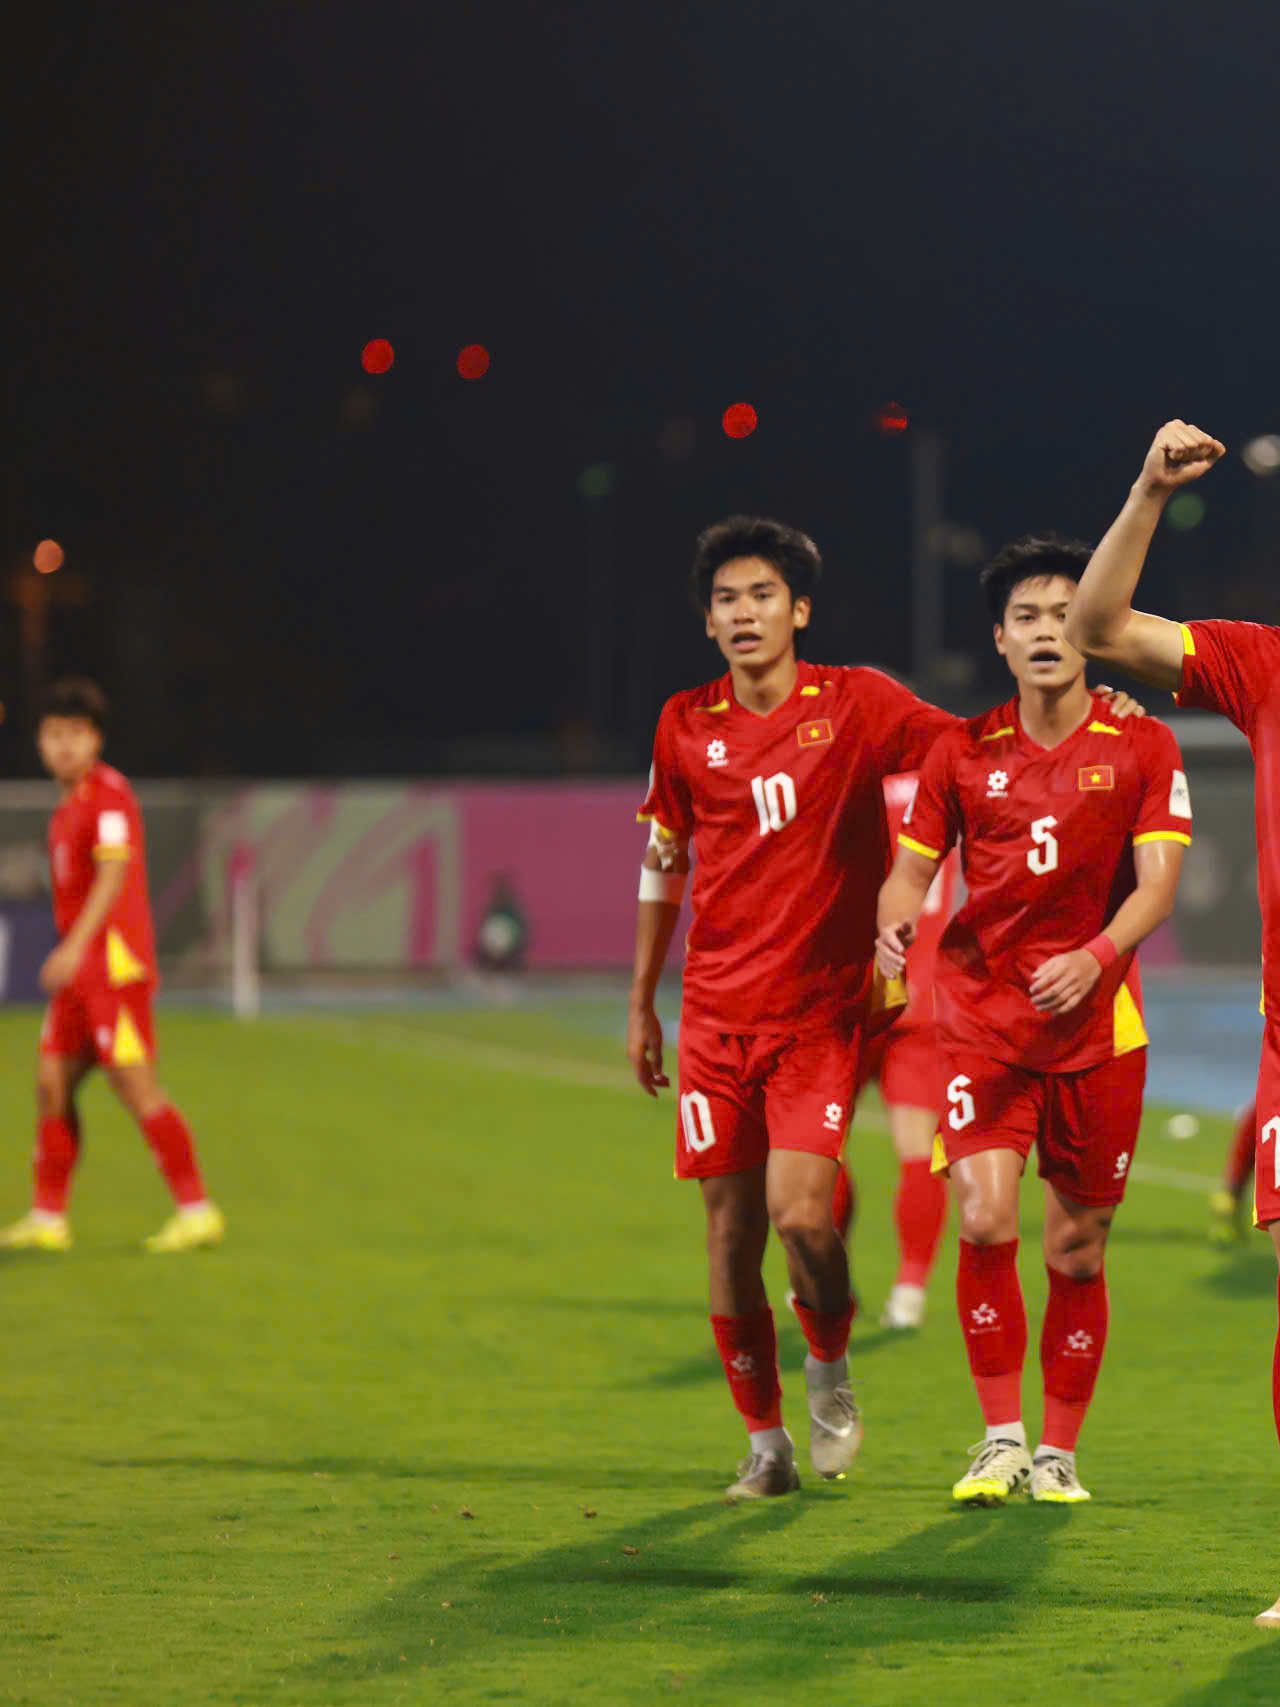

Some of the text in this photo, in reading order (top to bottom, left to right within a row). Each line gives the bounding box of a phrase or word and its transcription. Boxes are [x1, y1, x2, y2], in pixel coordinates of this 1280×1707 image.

[750, 771, 797, 837] 10
[1026, 815, 1058, 876] 5
[946, 1074, 975, 1131] 5
